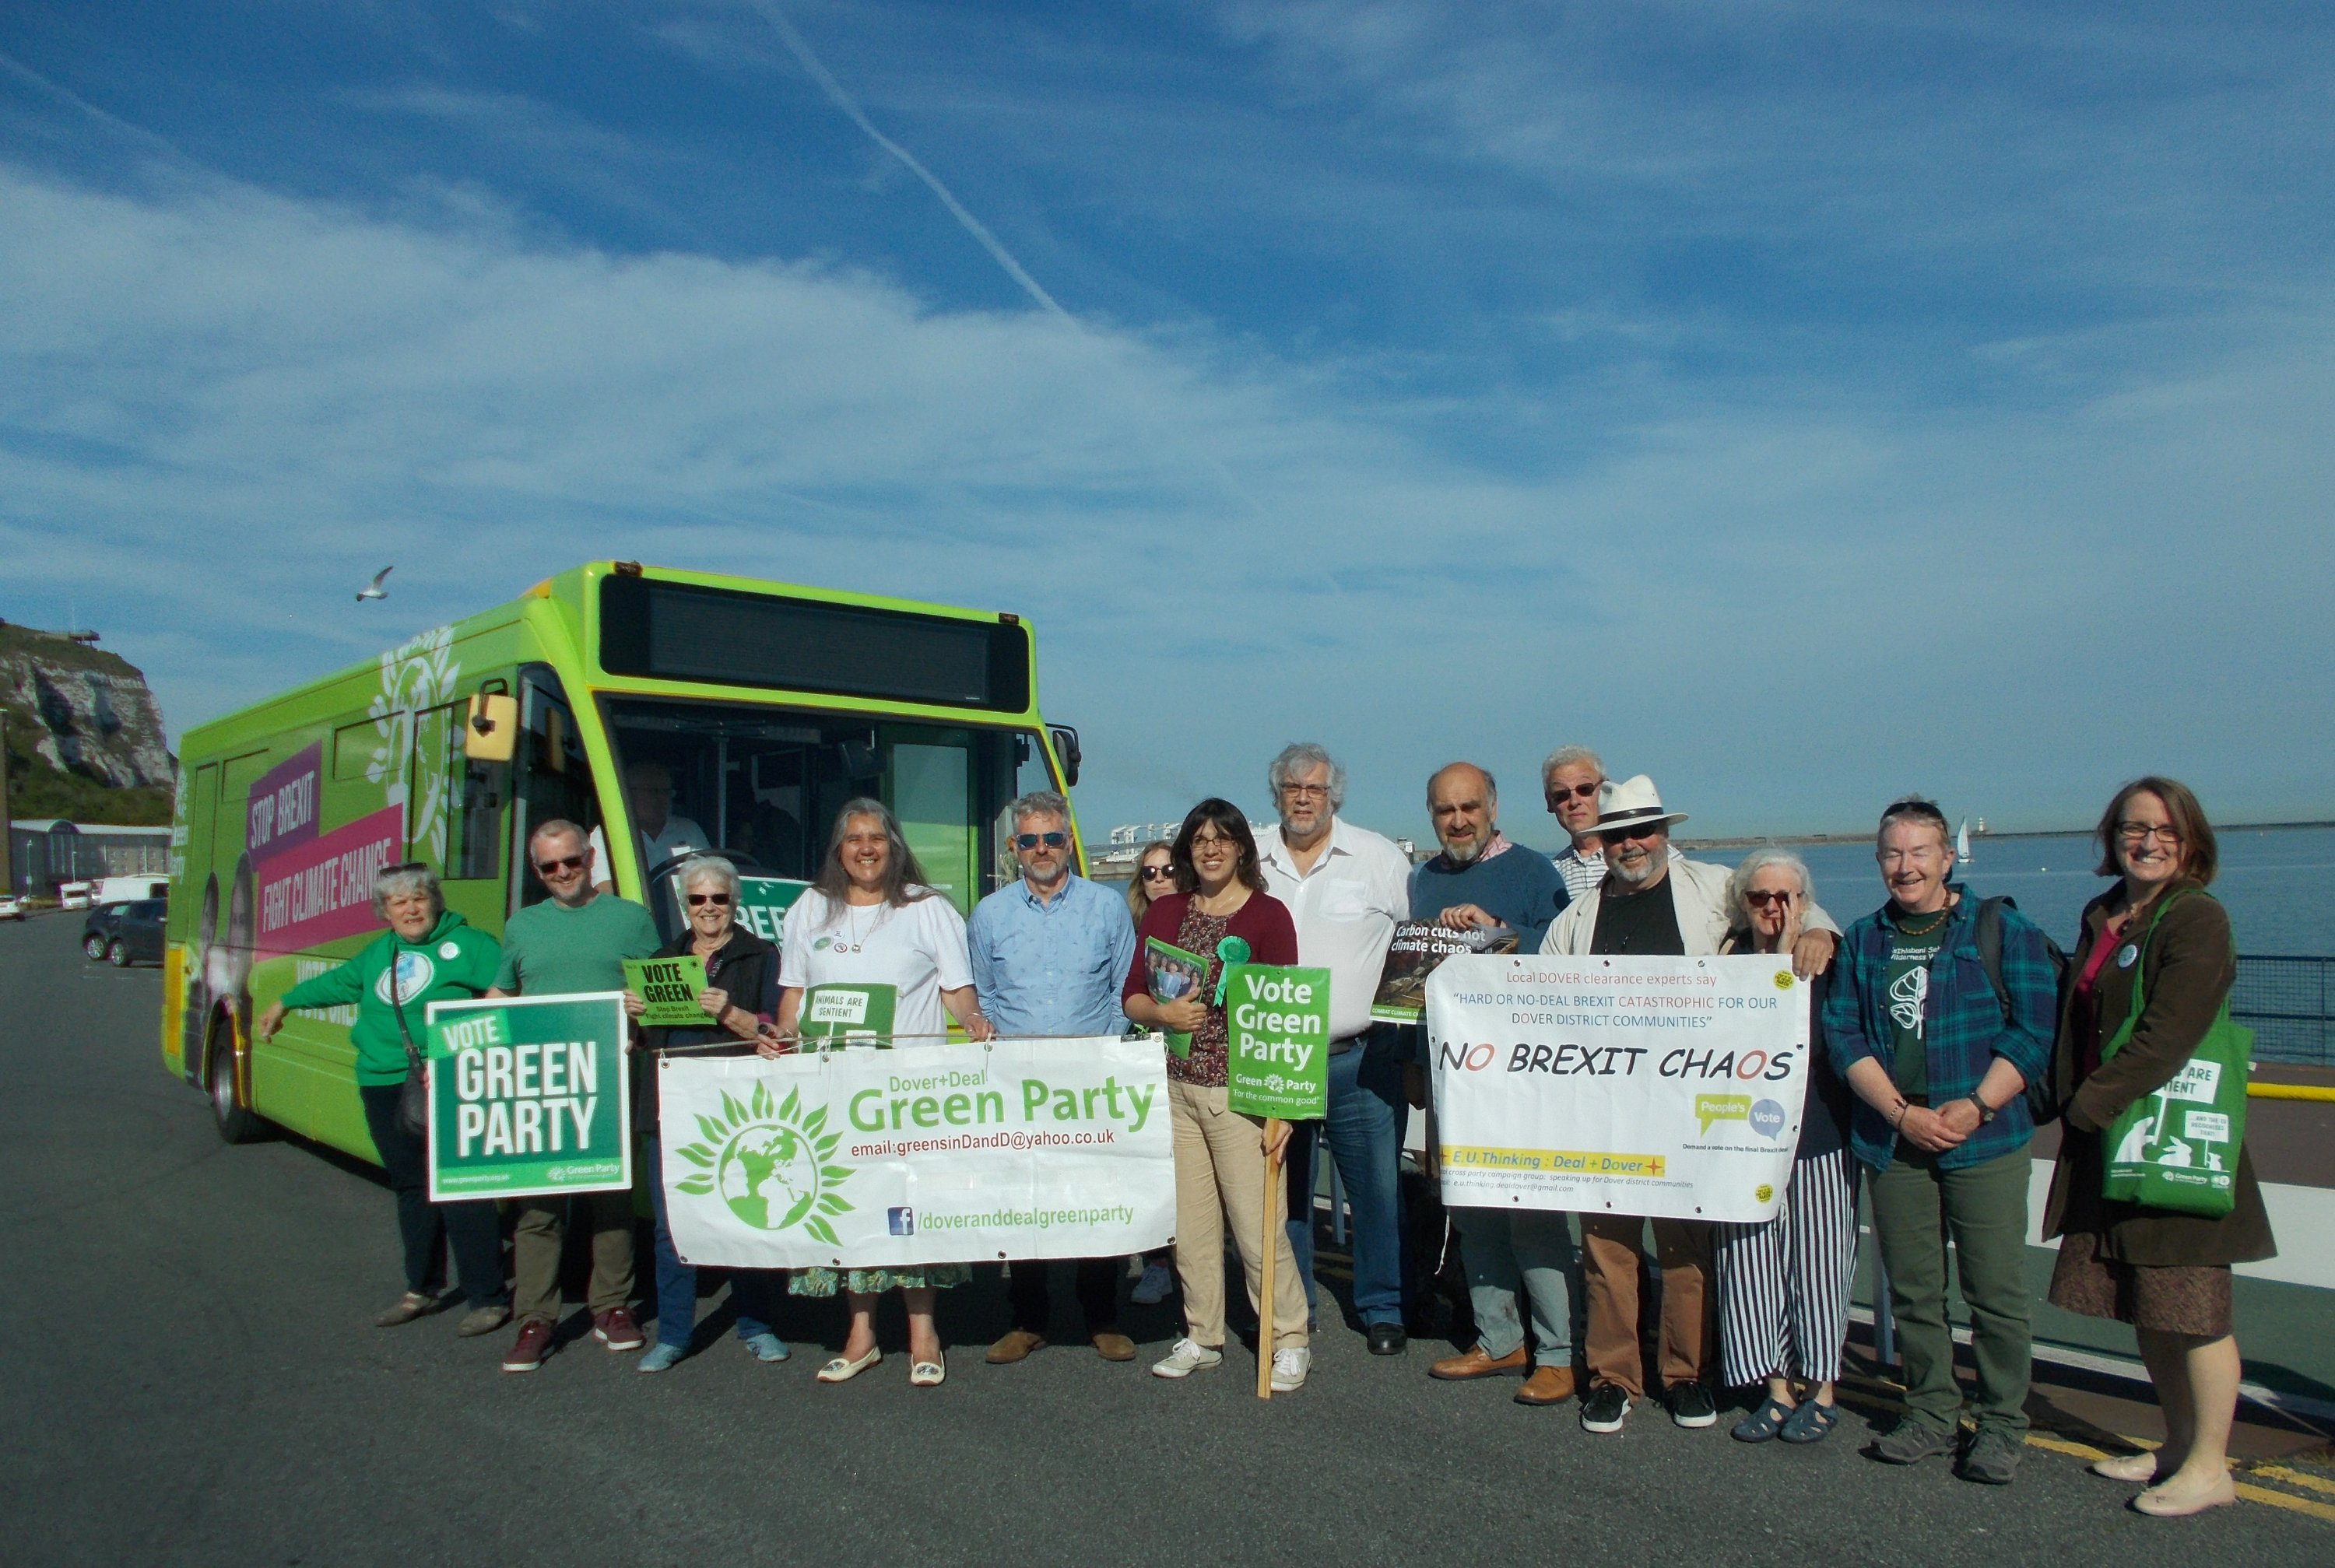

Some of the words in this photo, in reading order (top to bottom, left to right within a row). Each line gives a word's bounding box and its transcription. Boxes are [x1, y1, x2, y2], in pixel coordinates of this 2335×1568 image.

[251, 794, 275, 848] STOP
[277, 770, 314, 837] BREXIT
[262, 876, 292, 933] FIGHT
[292, 857, 339, 924] CLIMATE
[1396, 924, 1428, 938] Carbon
[1431, 927, 1459, 939] cuts
[1462, 929, 1487, 942] not
[1391, 938, 1428, 952] climate
[1431, 939, 1473, 955] chaos
[641, 963, 683, 984] VOTE
[1506, 971, 1536, 984] Local
[1539, 972, 1580, 984] DOVER
[1584, 973, 1643, 985] clearance
[1646, 974, 1693, 987] experts
[1696, 976, 1717, 987] say
[643, 983, 695, 1003] GREEN
[1245, 973, 1312, 1005] Vote
[816, 994, 844, 1005] ANIMALS
[846, 997, 863, 1007] ARE
[1453, 992, 1493, 1005] “HARD
[1496, 994, 1513, 1005] OR
[1517, 994, 1570, 1007] NO-DEAL
[1573, 995, 1615, 1007] BREXIT
[1618, 996, 1714, 1009] CATASTROPHIC
[1719, 997, 1744, 1009] FOR
[1748, 997, 1777, 1009] OUR
[818, 1007, 853, 1018] SENTIENT
[1235, 1003, 1321, 1035] Green
[1512, 1012, 1554, 1025] DOVER
[1556, 1014, 1609, 1026] DISTRICT
[1612, 1015, 1712, 1028] COMMUNITIES”
[442, 1016, 500, 1052] VOTE
[1240, 1032, 1314, 1072] Party
[1438, 1041, 1496, 1072] NO
[1507, 1043, 1649, 1076] BREXIT
[1659, 1047, 1794, 1082] CHAOS
[457, 1041, 598, 1101] GREEN
[889, 1069, 987, 1093] Dover+Deal
[2187, 1067, 2213, 1082] ARE
[1235, 1073, 1262, 1087] Green
[1286, 1079, 1317, 1094] Party
[848, 1088, 1005, 1133] Green
[1021, 1075, 1157, 1133] Party
[1245, 1090, 1257, 1100] the
[1258, 1094, 1294, 1104] common
[1701, 1101, 1745, 1114] People's
[458, 1096, 599, 1157] PARTY
[1754, 1112, 1781, 1124] Vote
[851, 1128, 1115, 1157] email:greensinDandD@yahoo.co.uk
[567, 1165, 595, 1174] Green
[595, 1163, 620, 1175] Party
[1452, 1150, 1541, 1170] E.U.Thinking
[1554, 1156, 1586, 1169] Deal
[1601, 1158, 1644, 1172] Dover
[1453, 1180, 1574, 1192] e.u.thinking.dealdover@gmail.com
[1468, 1170, 1487, 1178] party
[1592, 1175, 1603, 1184] for
[918, 1204, 1134, 1230] /doveranddealgreenparty
